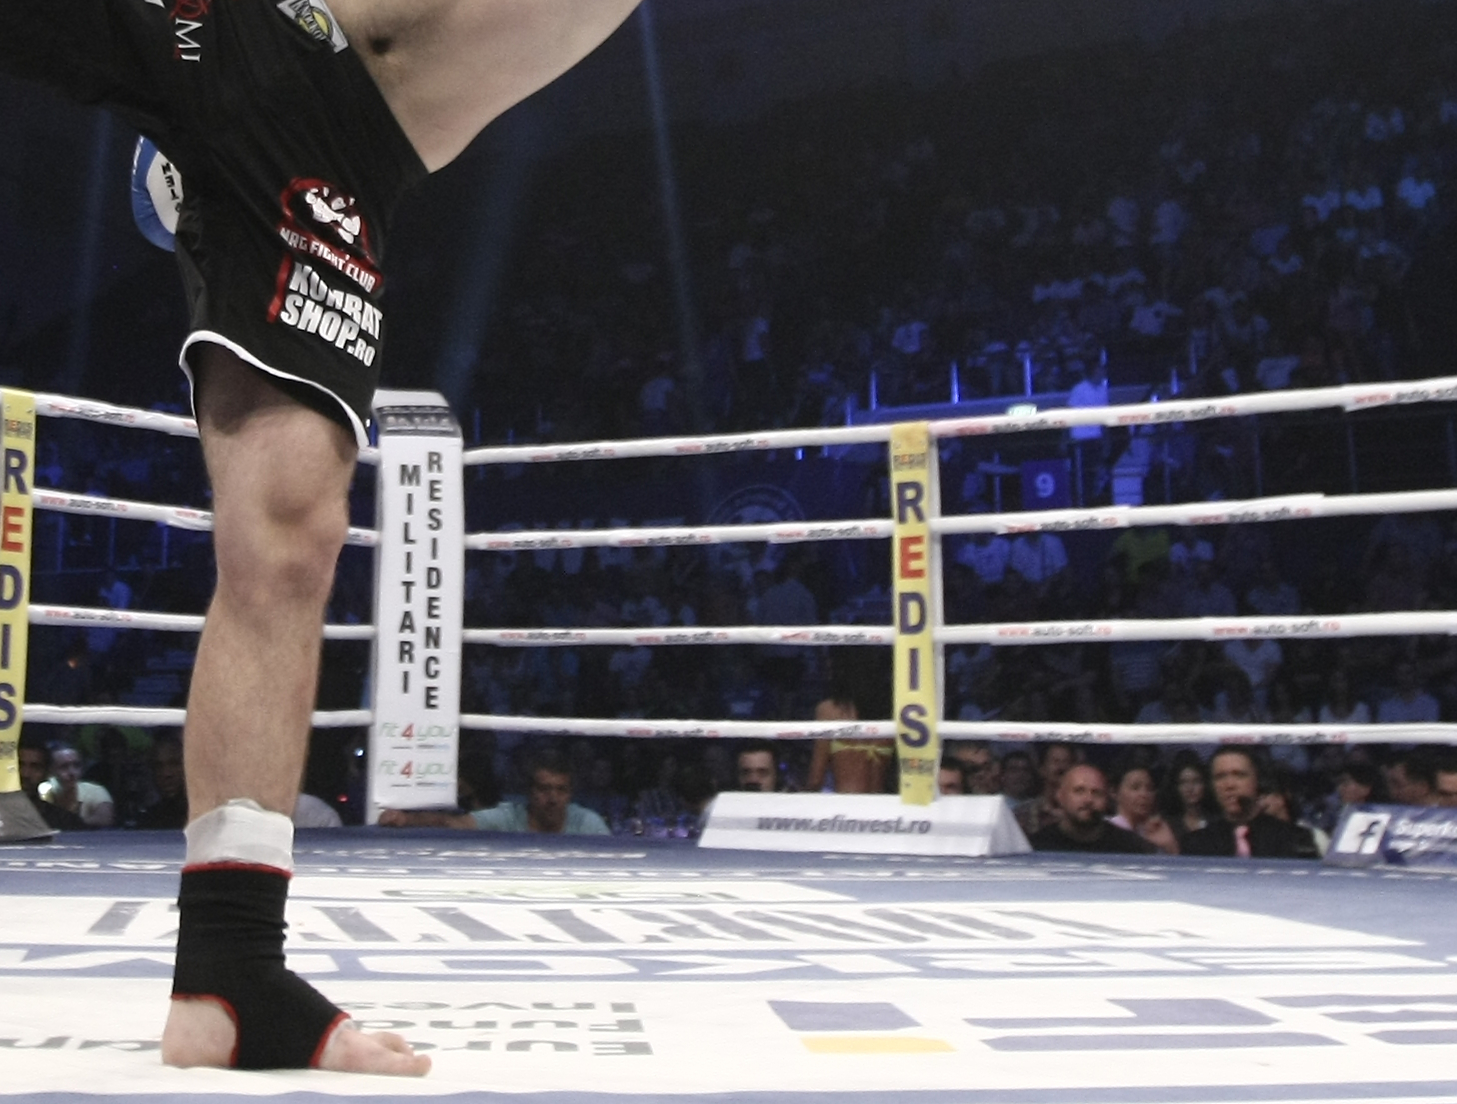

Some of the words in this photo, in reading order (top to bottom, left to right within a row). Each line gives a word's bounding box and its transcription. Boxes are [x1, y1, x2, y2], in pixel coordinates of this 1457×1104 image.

[345, 263, 376, 294] CLUB
[280, 294, 376, 367] SHOP.RO
[1036, 473, 1054, 497] 9
[397, 464, 421, 694] MILITARI
[424, 450, 443, 709] RESIDENCE
[896, 480, 931, 749] REDIS
[757, 813, 932, 835] www.efinvest.ro
[337, 1001, 638, 1014] Inves
[344, 1018, 645, 1034] Fund
